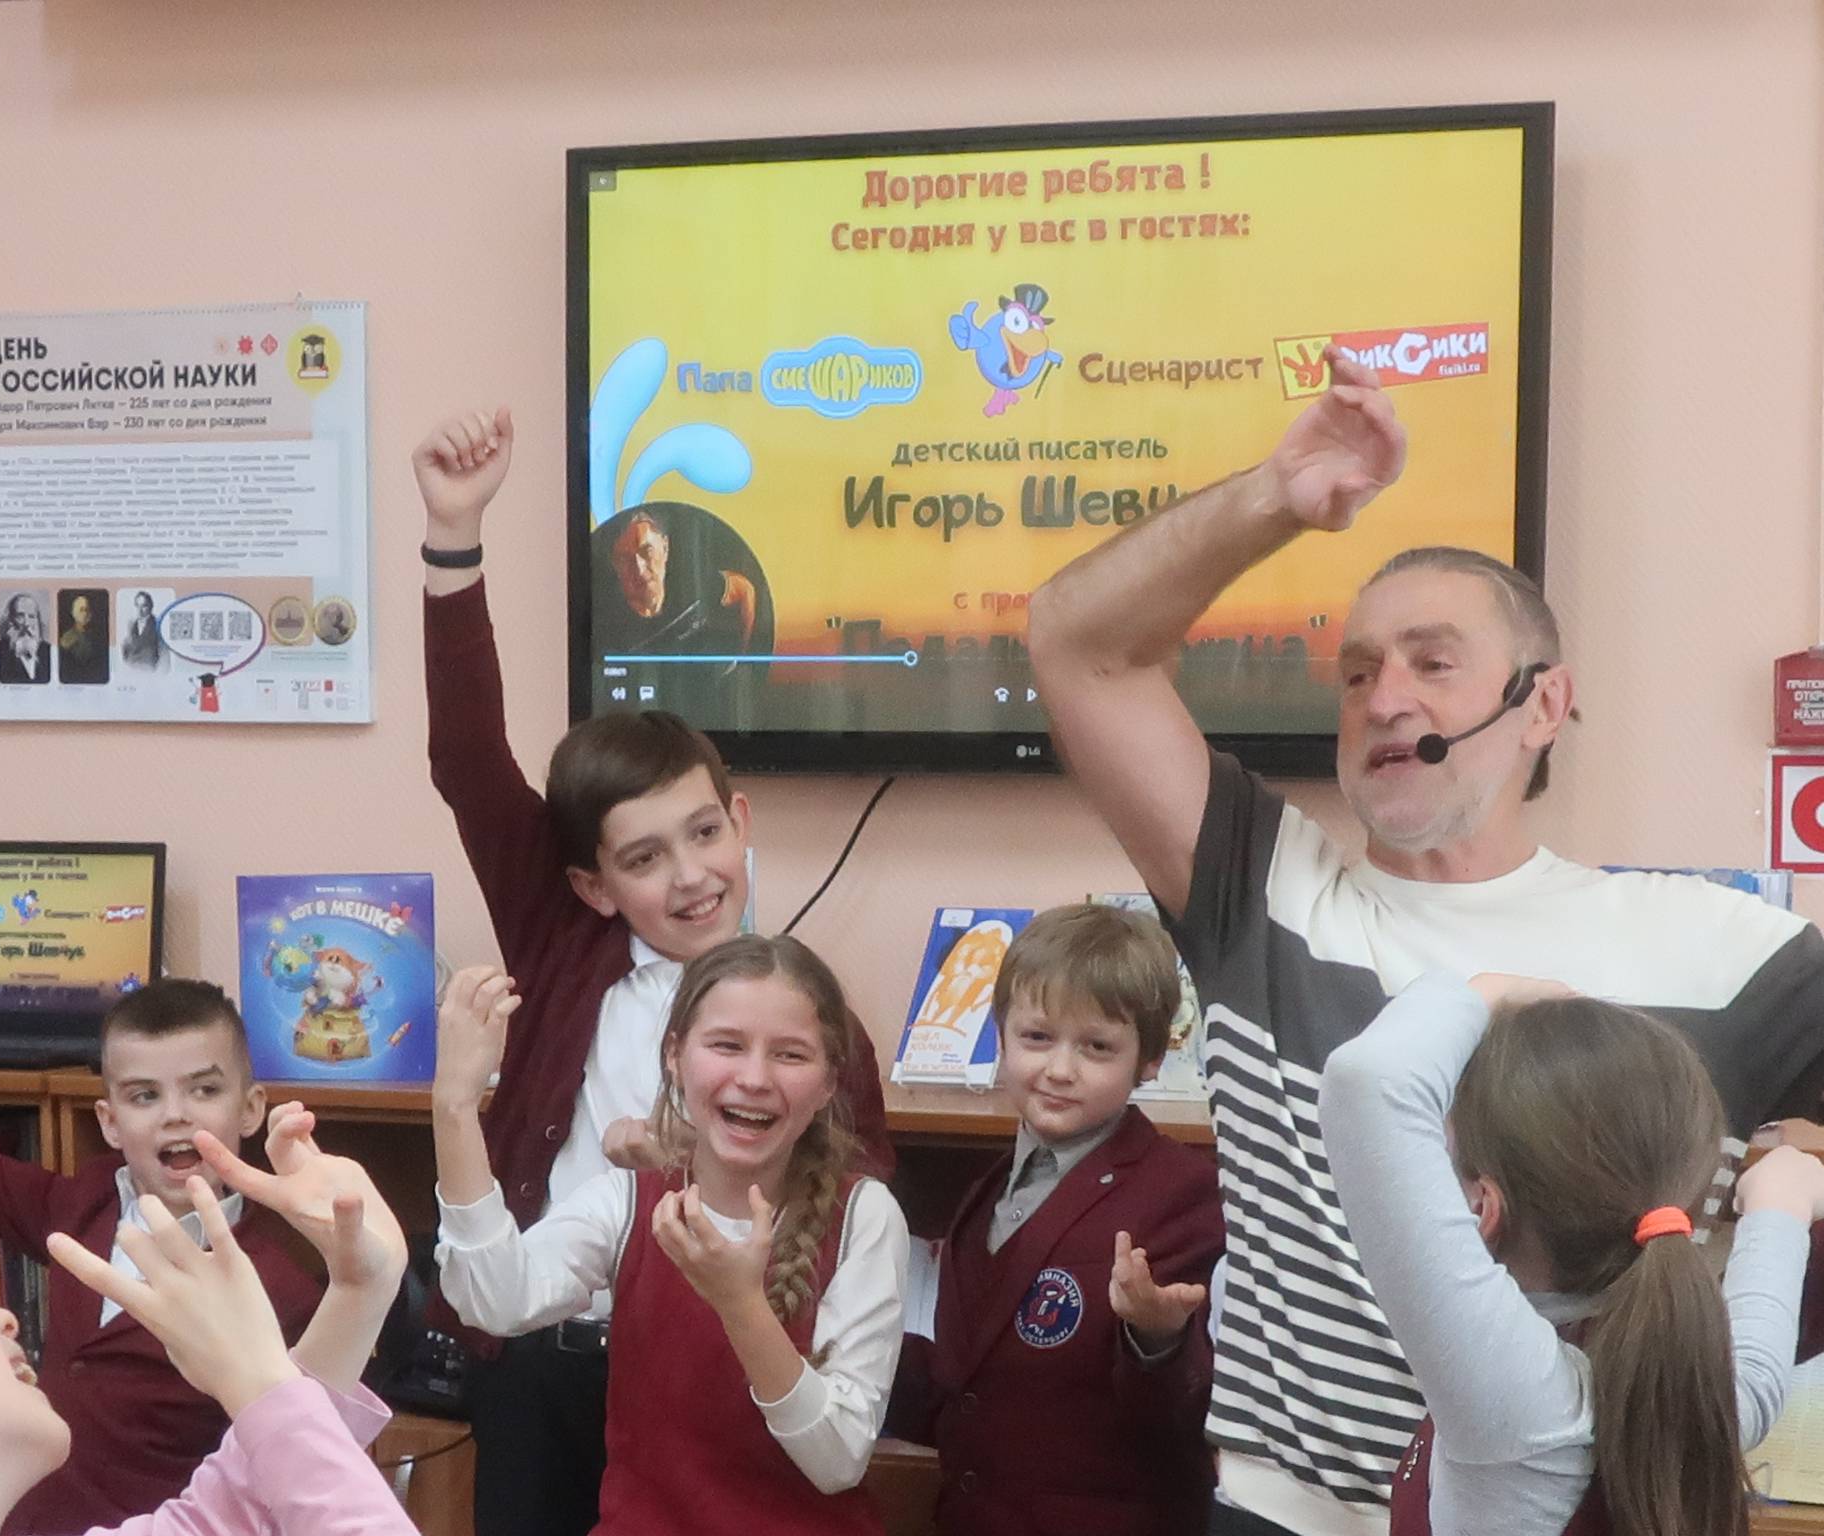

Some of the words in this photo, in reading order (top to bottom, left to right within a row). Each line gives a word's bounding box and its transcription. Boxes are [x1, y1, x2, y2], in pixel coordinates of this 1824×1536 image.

[862, 167, 1028, 209] Дорогие
[1043, 160, 1186, 203] ребята
[831, 221, 975, 253] Сегодня
[987, 224, 1007, 253] у
[1019, 218, 1076, 244] вас
[1088, 218, 1107, 242] в
[1120, 213, 1252, 242] гостях:
[175, 362, 257, 389] НАУКИ
[676, 363, 754, 393] Папа
[772, 353, 915, 402] СМЕШАРИКОВ
[1078, 352, 1265, 389] Сценарист
[129, 396, 149, 410] 225
[124, 416, 144, 429] 230
[890, 437, 1021, 468] детский
[1028, 436, 1169, 463] писатель
[843, 475, 1006, 543] Игорь
[1020, 473, 1188, 529] Шевч
[330, 899, 406, 936] МЕШКЕ
